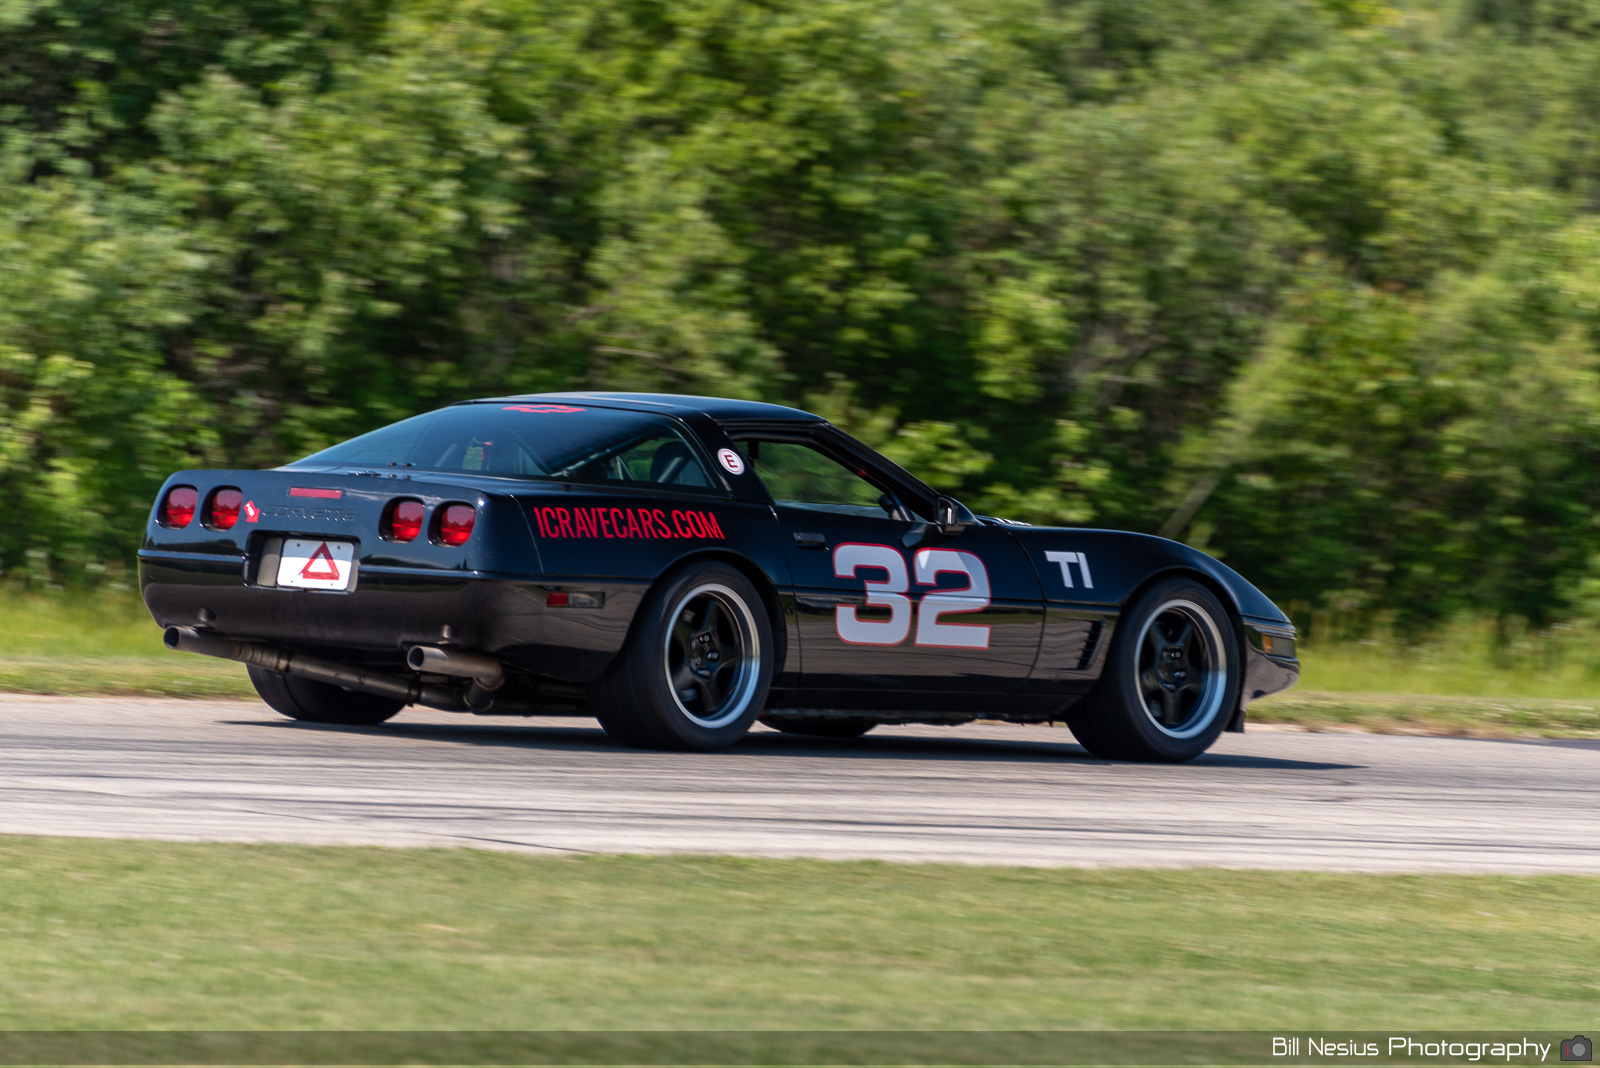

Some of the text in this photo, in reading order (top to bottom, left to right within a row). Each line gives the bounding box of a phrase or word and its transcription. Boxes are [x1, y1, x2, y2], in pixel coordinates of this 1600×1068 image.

[723, 453, 738, 469] E
[533, 506, 726, 540] ICRAVECARS.COM
[832, 541, 992, 650] 32
